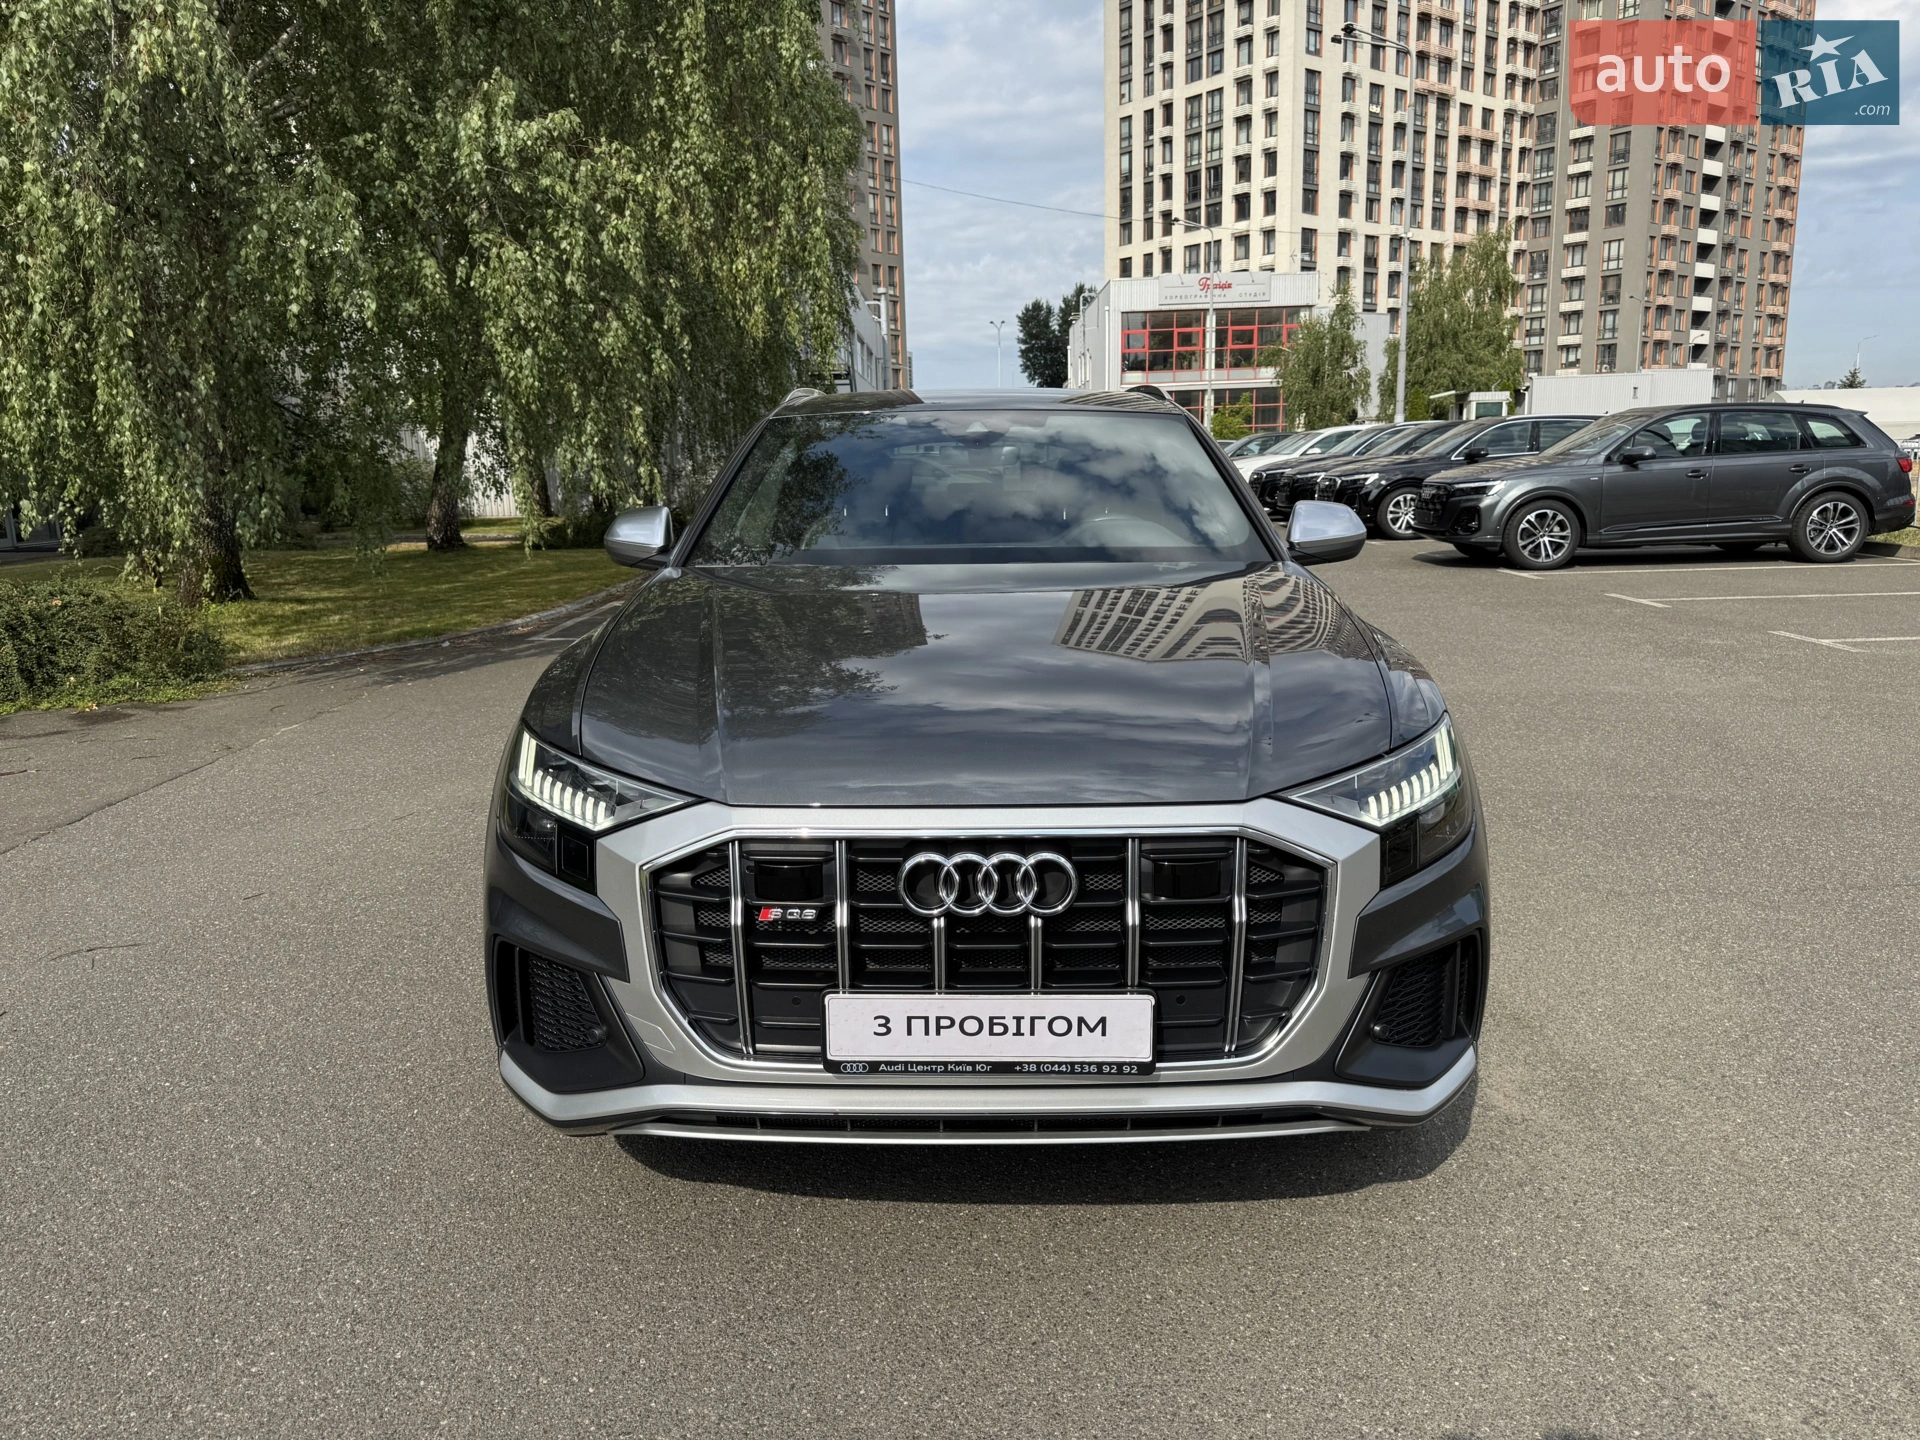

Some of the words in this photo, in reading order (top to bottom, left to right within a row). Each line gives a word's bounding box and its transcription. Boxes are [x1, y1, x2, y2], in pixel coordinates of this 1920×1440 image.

[873, 1014, 892, 1037] З
[906, 1015, 1107, 1037] ПРОБІГОМ
[879, 1063, 905, 1072] Audi
[908, 1063, 945, 1073] Центр
[948, 1063, 973, 1072] Київ
[976, 1063, 992, 1072] Юг
[1014, 1063, 1037, 1072] +38
[1040, 1063, 1071, 1073] (044)
[1074, 1064, 1098, 1073] 536
[1102, 1065, 1118, 1073] 92
[1122, 1065, 1138, 1074] 92
